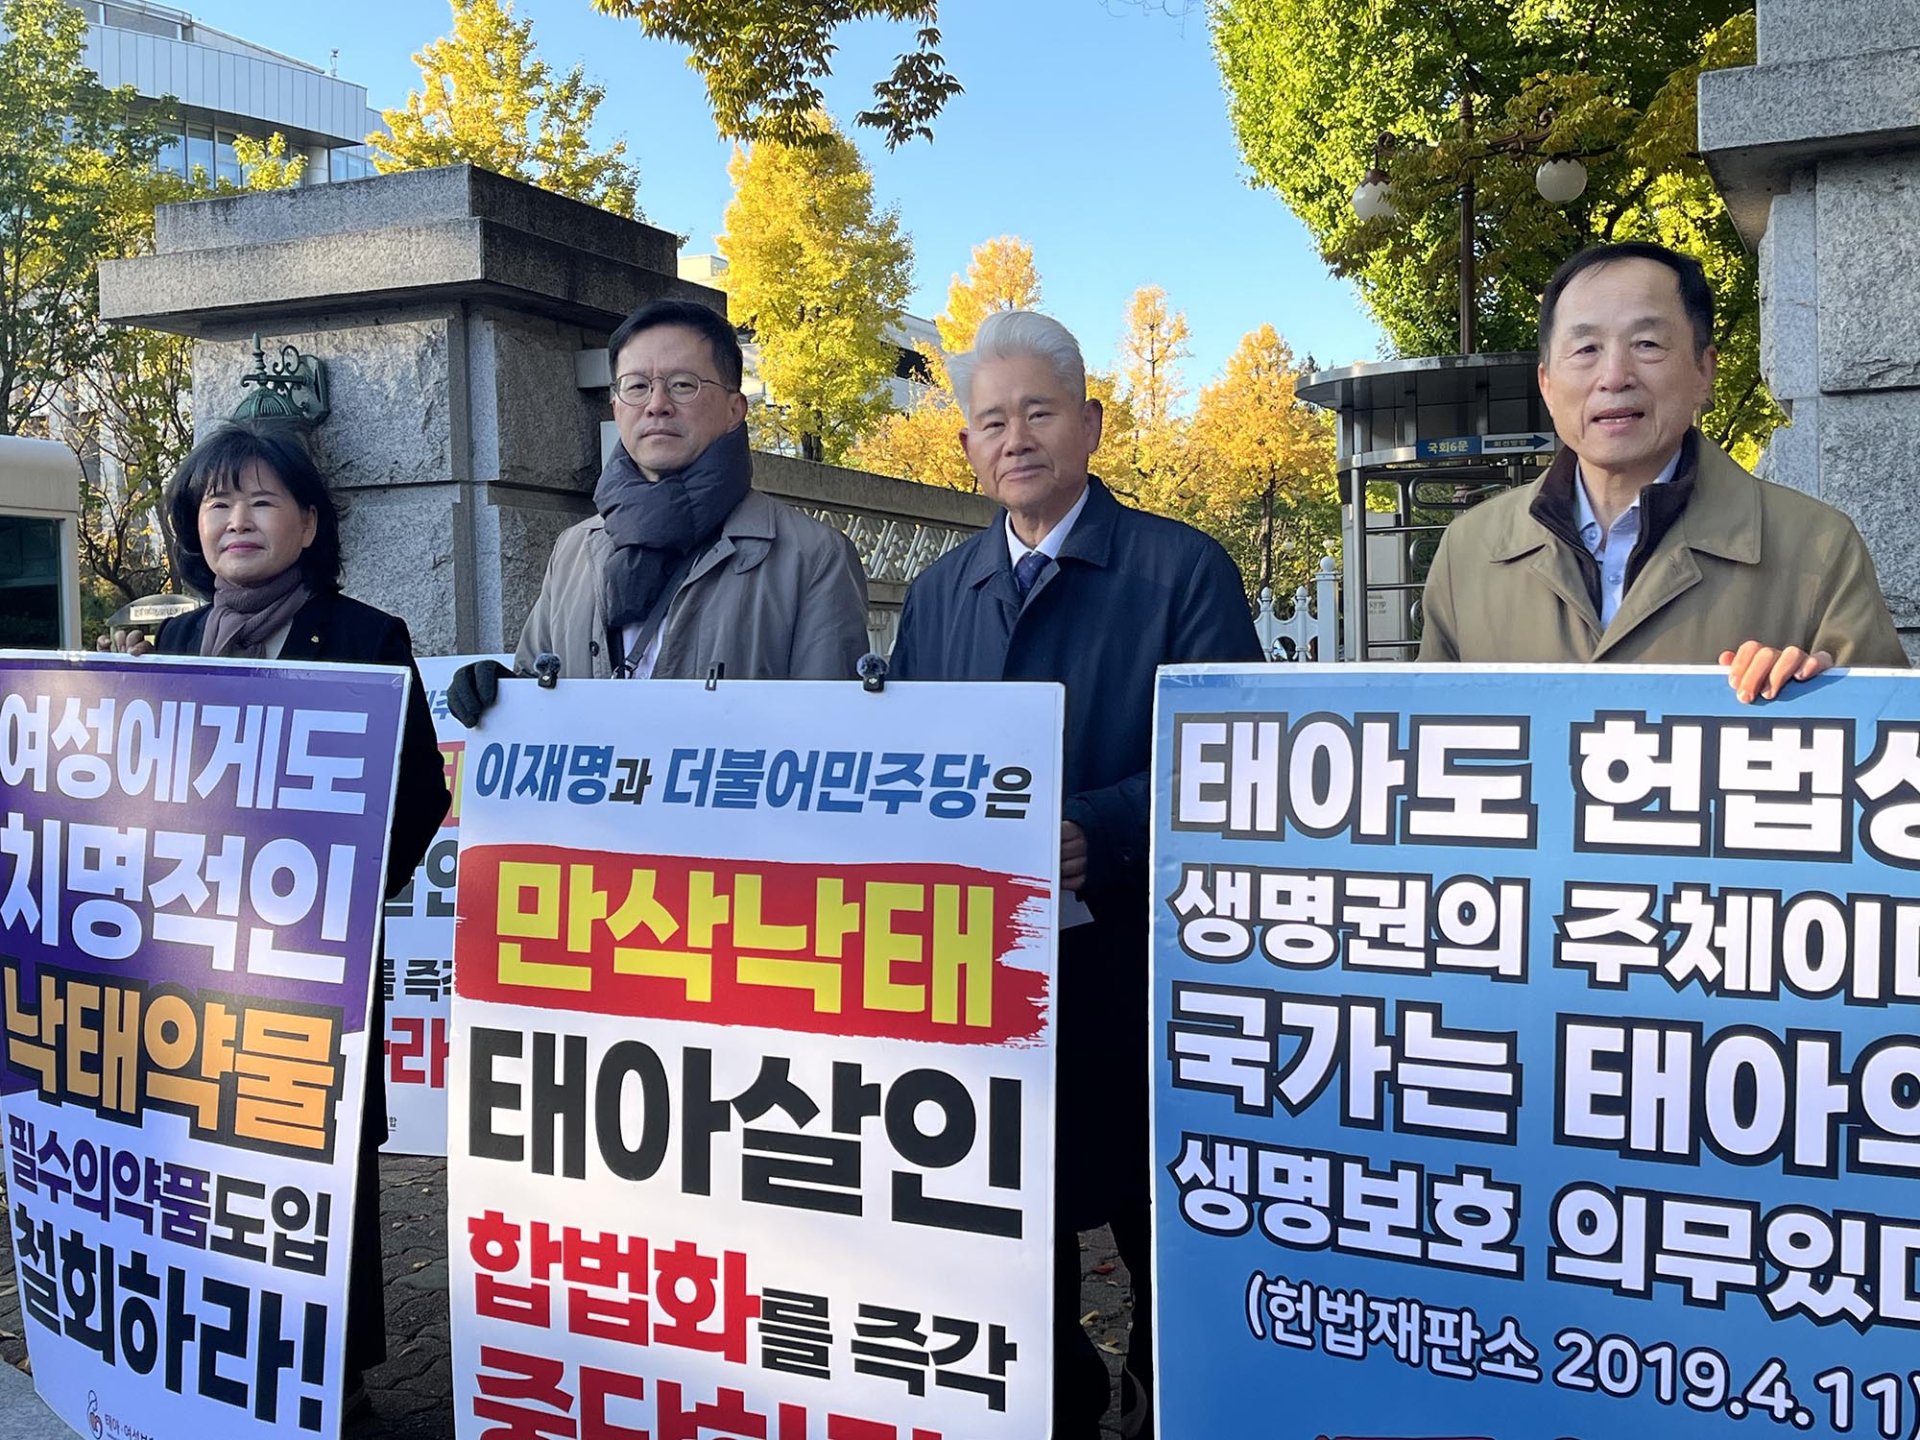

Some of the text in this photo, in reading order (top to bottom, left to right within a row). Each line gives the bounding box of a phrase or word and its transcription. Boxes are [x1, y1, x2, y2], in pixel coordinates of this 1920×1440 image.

[1427, 440, 1469, 454] 국회6문
[0, 693, 368, 815] 여성에게도
[476, 742, 652, 806] 이재명과
[661, 748, 1033, 819] 더불어민주당은
[1175, 714, 1534, 846] 태아도
[0, 812, 356, 984] 치명적인
[496, 861, 994, 1028] 만삭낙태
[1172, 868, 1920, 1001] 생명권의 주체이
[4, 966, 335, 1150] 낙태약물
[1172, 988, 1516, 1136] 국가는
[8, 1113, 331, 1276] 필수의약품도입
[468, 1026, 1023, 1240] 태아살인
[1172, 1136, 1520, 1276] 생명보호
[14, 1201, 328, 1433] 철회하라!
[467, 1209, 1018, 1412] 합법화를 즉각
[1246, 1272, 1541, 1380] (헌법재판소
